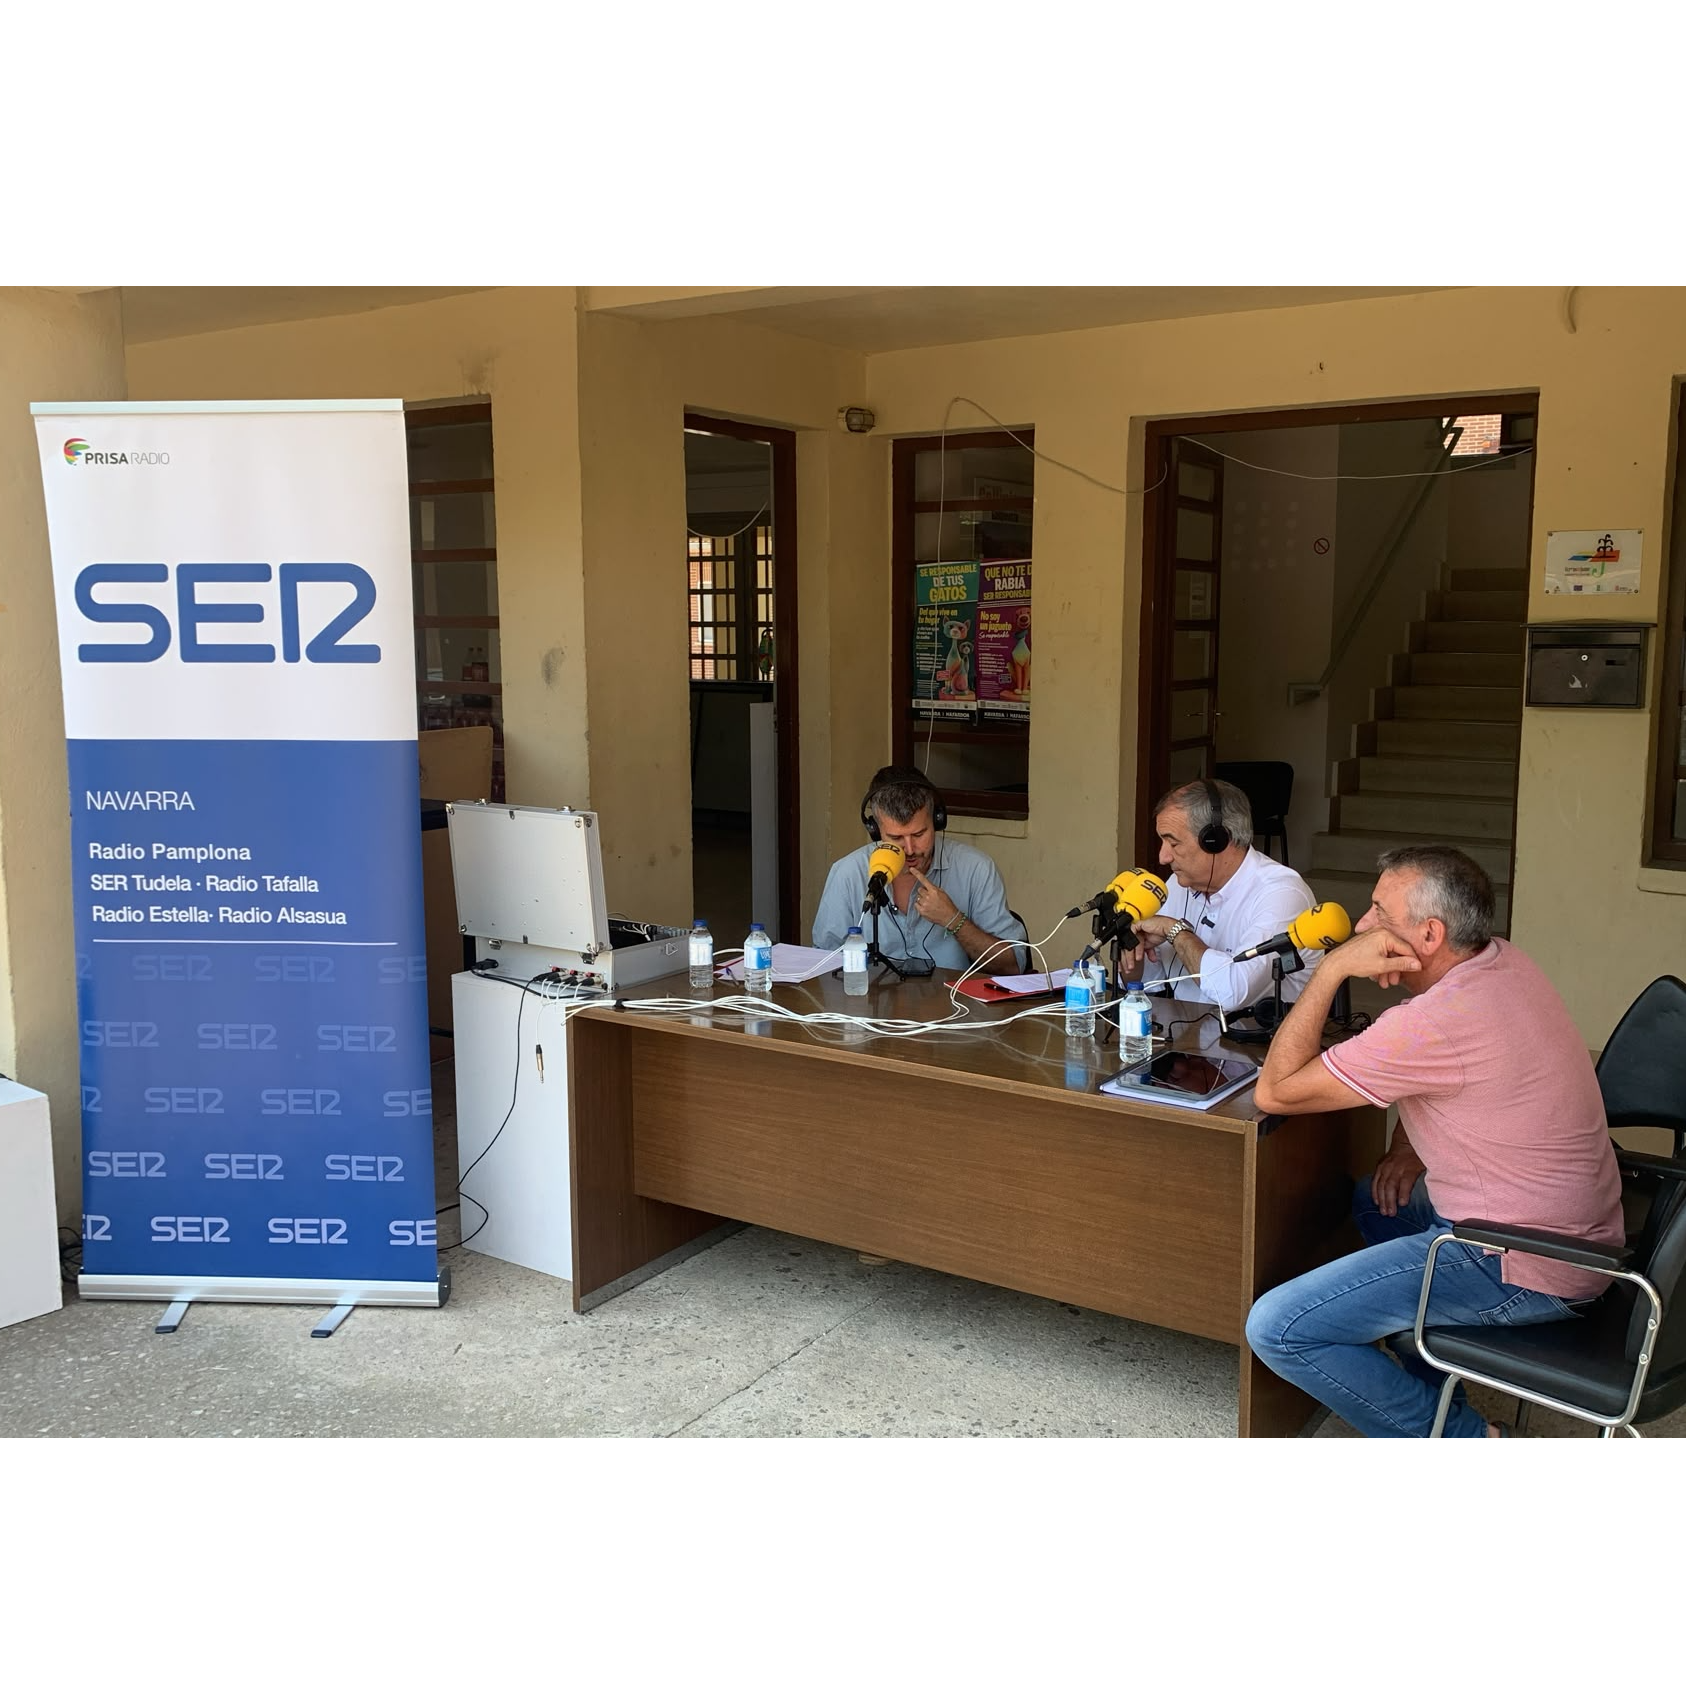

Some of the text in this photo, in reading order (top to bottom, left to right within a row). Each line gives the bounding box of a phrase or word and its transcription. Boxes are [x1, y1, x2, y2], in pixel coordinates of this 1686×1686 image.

[85, 452, 170, 465] PRISA RADIO
[920, 564, 977, 577] SE RESPONSABLE
[984, 564, 1032, 581] QUE NO TE D
[933, 575, 964, 587] DE TUS
[994, 577, 1026, 591] RABIA
[929, 585, 967, 602] GATOS
[74, 562, 382, 663] SER
[980, 611, 1001, 623] No soy
[86, 790, 195, 811] NAVARRA
[89, 843, 251, 863] Radio Pamplona
[90, 874, 128, 891] SER
[132, 875, 192, 892] Tudela
[206, 875, 259, 892] Radio
[262, 875, 319, 893] Tafalla
[92, 906, 144, 923] Radio
[219, 907, 273, 924] Radio
[277, 908, 347, 925] Alsasua
[254, 955, 336, 983] SER
[378, 956, 427, 984] SE
[83, 1020, 397, 1052] SER SER SER
[144, 1087, 432, 1117] SER SER SE
[88, 1151, 405, 1181] SER SER SER
[150, 1216, 437, 1246] SER SER SE
